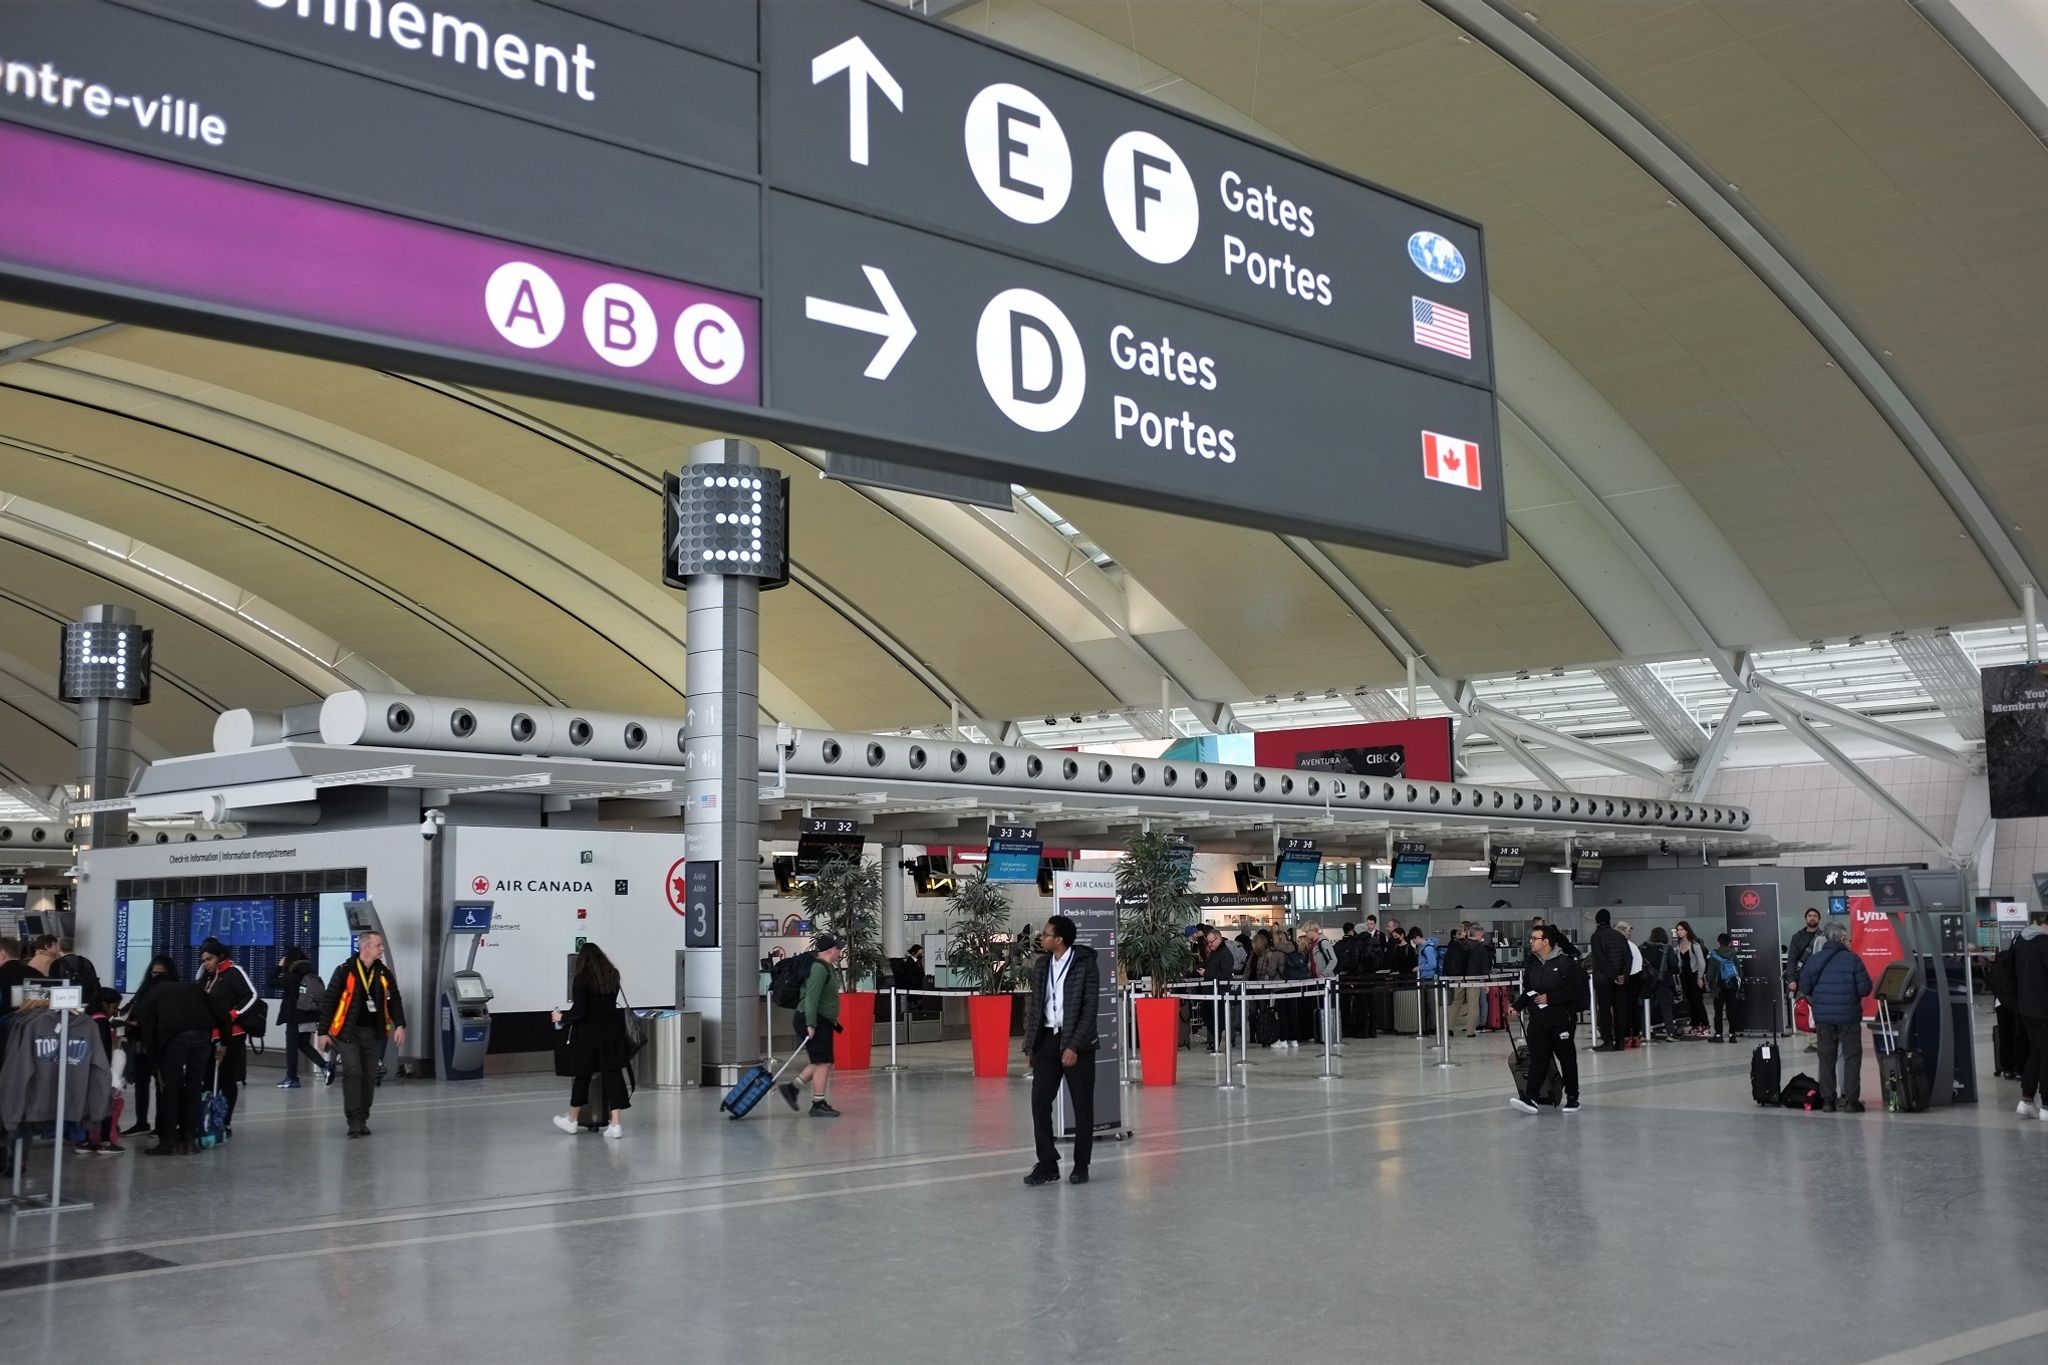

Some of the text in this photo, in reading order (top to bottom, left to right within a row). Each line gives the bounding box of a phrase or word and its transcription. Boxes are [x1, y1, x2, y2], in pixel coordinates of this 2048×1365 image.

[0, 56, 227, 146] ntre-ville
[1220, 170, 1316, 238] Gates
[1223, 234, 1333, 306] Portes
[1109, 324, 1218, 391] Gates
[1113, 395, 1237, 464] Portes
[703, 475, 762, 563] 3
[82, 631, 128, 689] 4
[1992, 702, 2036, 713] Member
[1301, 753, 1389, 767] AVENTURA CIBC
[169, 854, 189, 864] Check-in
[190, 852, 219, 863] Information
[222, 851, 251, 861] Information
[252, 848, 297, 861] d'enregistrement
[495, 880, 593, 892] AIR CANADA
[693, 872, 707, 881] Aisle
[1075, 881, 1114, 889] AIR CANADA
[488, 923, 520, 931] strement
[693, 902, 707, 938] 3
[1856, 909, 1889, 924] Lynx
